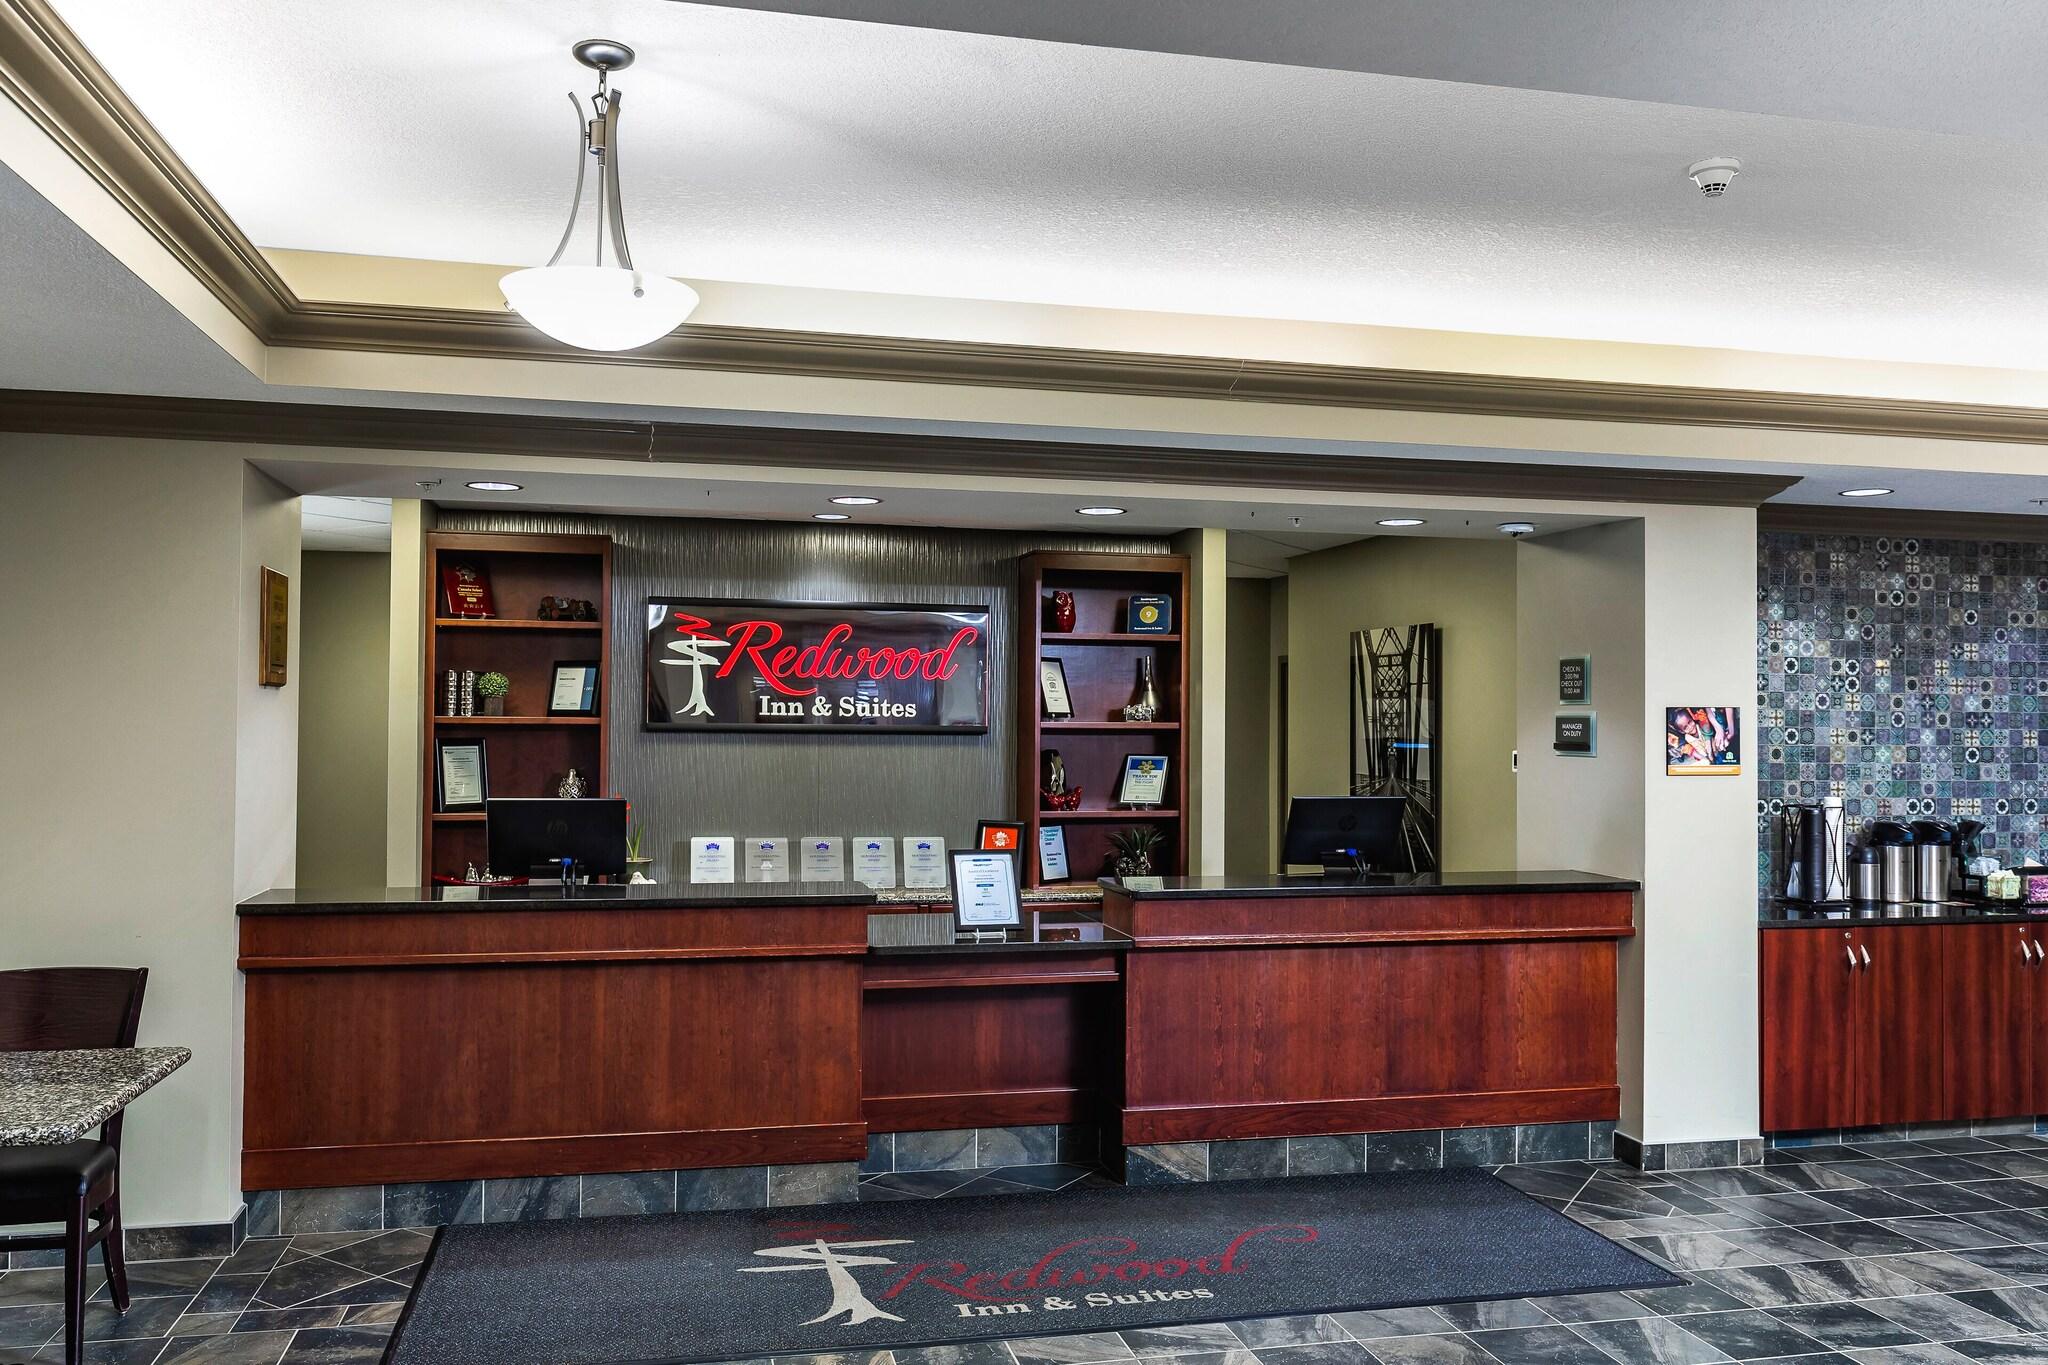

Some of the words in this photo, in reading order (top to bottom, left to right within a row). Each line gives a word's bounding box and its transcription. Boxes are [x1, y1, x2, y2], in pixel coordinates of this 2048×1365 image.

[1146, 610, 1152, 618] 9
[715, 620, 978, 696] Redwood
[759, 696, 805, 717] Inn
[808, 696, 833, 717] &
[839, 697, 917, 718] Suites
[881, 1224, 1319, 1301] Redwood
[953, 1299, 1031, 1319] Inn
[1043, 1295, 1078, 1311] &
[1085, 1286, 1215, 1310] Suites
